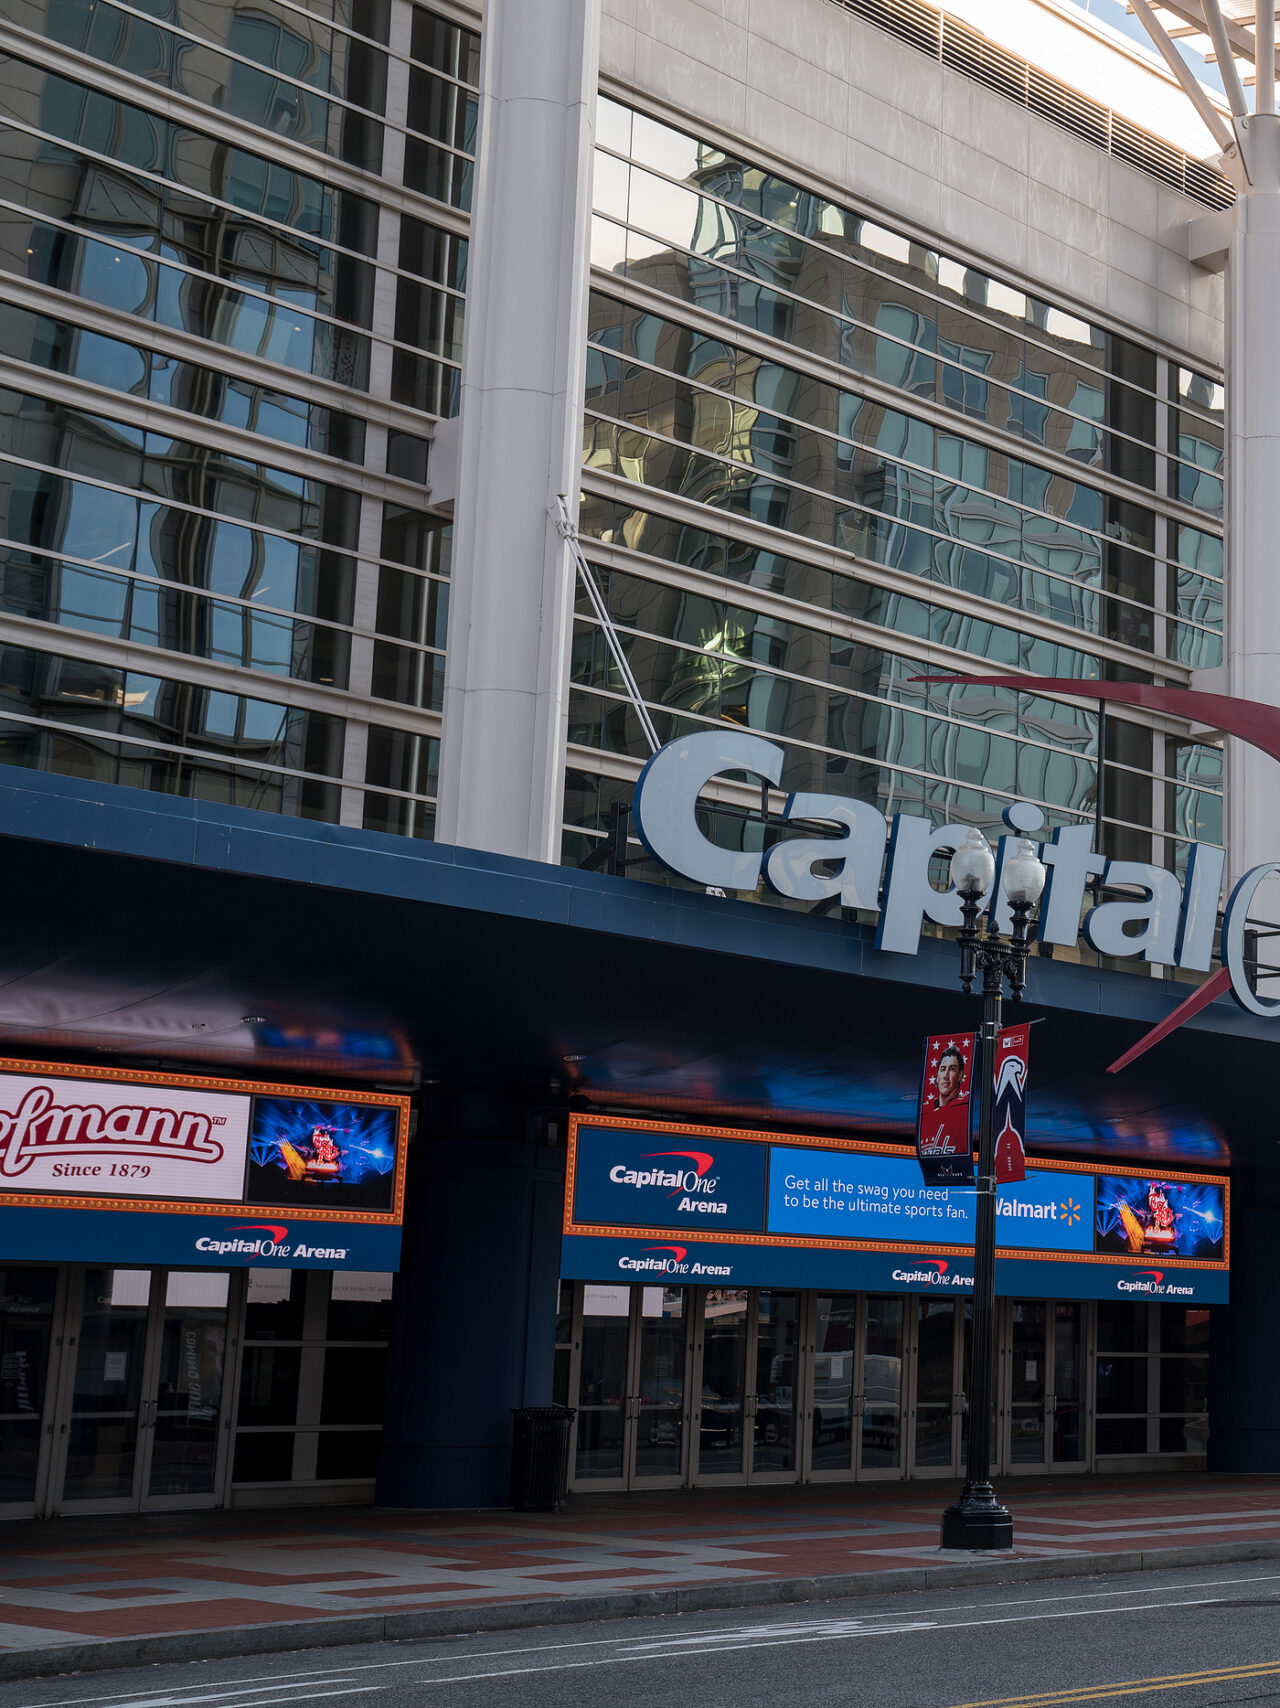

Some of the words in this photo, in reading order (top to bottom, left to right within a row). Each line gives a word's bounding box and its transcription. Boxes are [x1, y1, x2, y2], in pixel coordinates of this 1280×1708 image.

[52, 1163, 102, 1178] Since
[109, 1163, 151, 1179] 1879
[784, 1174, 810, 1191] Get
[813, 1178, 829, 1192] all
[832, 1179, 854, 1194] the
[857, 1184, 889, 1200] swag
[892, 1186, 915, 1201] you
[918, 1188, 949, 1201] need
[677, 1197, 728, 1214] Arena
[784, 1194, 799, 1207] to
[802, 1194, 819, 1208] be
[823, 1196, 845, 1210] the
[848, 1198, 901, 1214] ultimate
[904, 1204, 943, 1219] sports
[946, 1205, 968, 1219] fan.
[293, 1244, 346, 1259] Arena
[690, 1263, 731, 1276] Arena
[951, 1274, 975, 1286] Are
[1166, 1284, 1194, 1295] Arena
